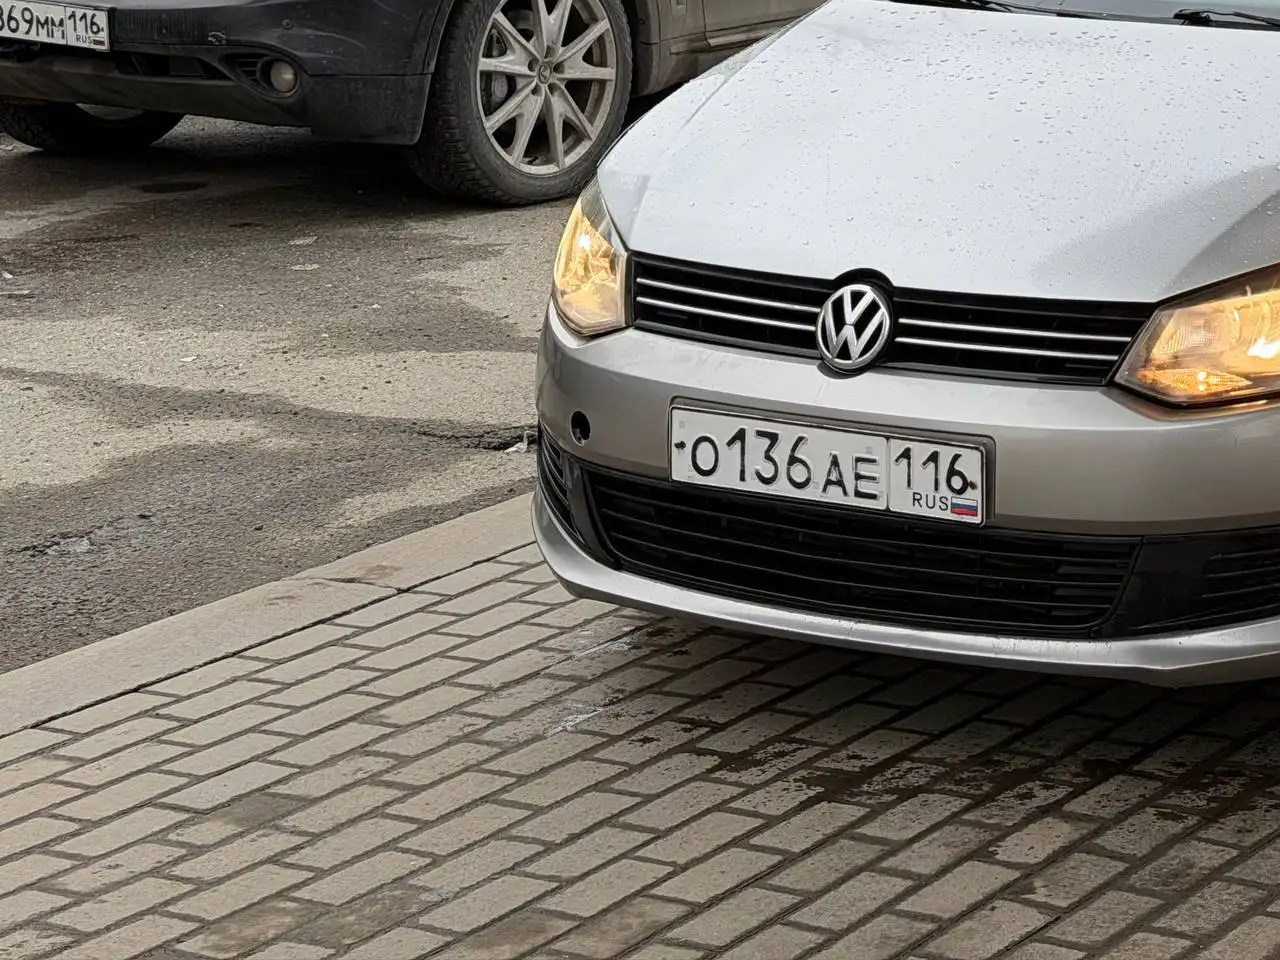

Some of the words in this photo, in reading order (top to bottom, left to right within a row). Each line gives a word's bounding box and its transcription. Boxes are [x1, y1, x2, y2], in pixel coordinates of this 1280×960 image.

[68, 11, 101, 35] 116
[75, 34, 93, 44] RUS
[691, 427, 878, 501] О136АЕ
[895, 446, 969, 495] 116
[913, 492, 949, 511] RUS
